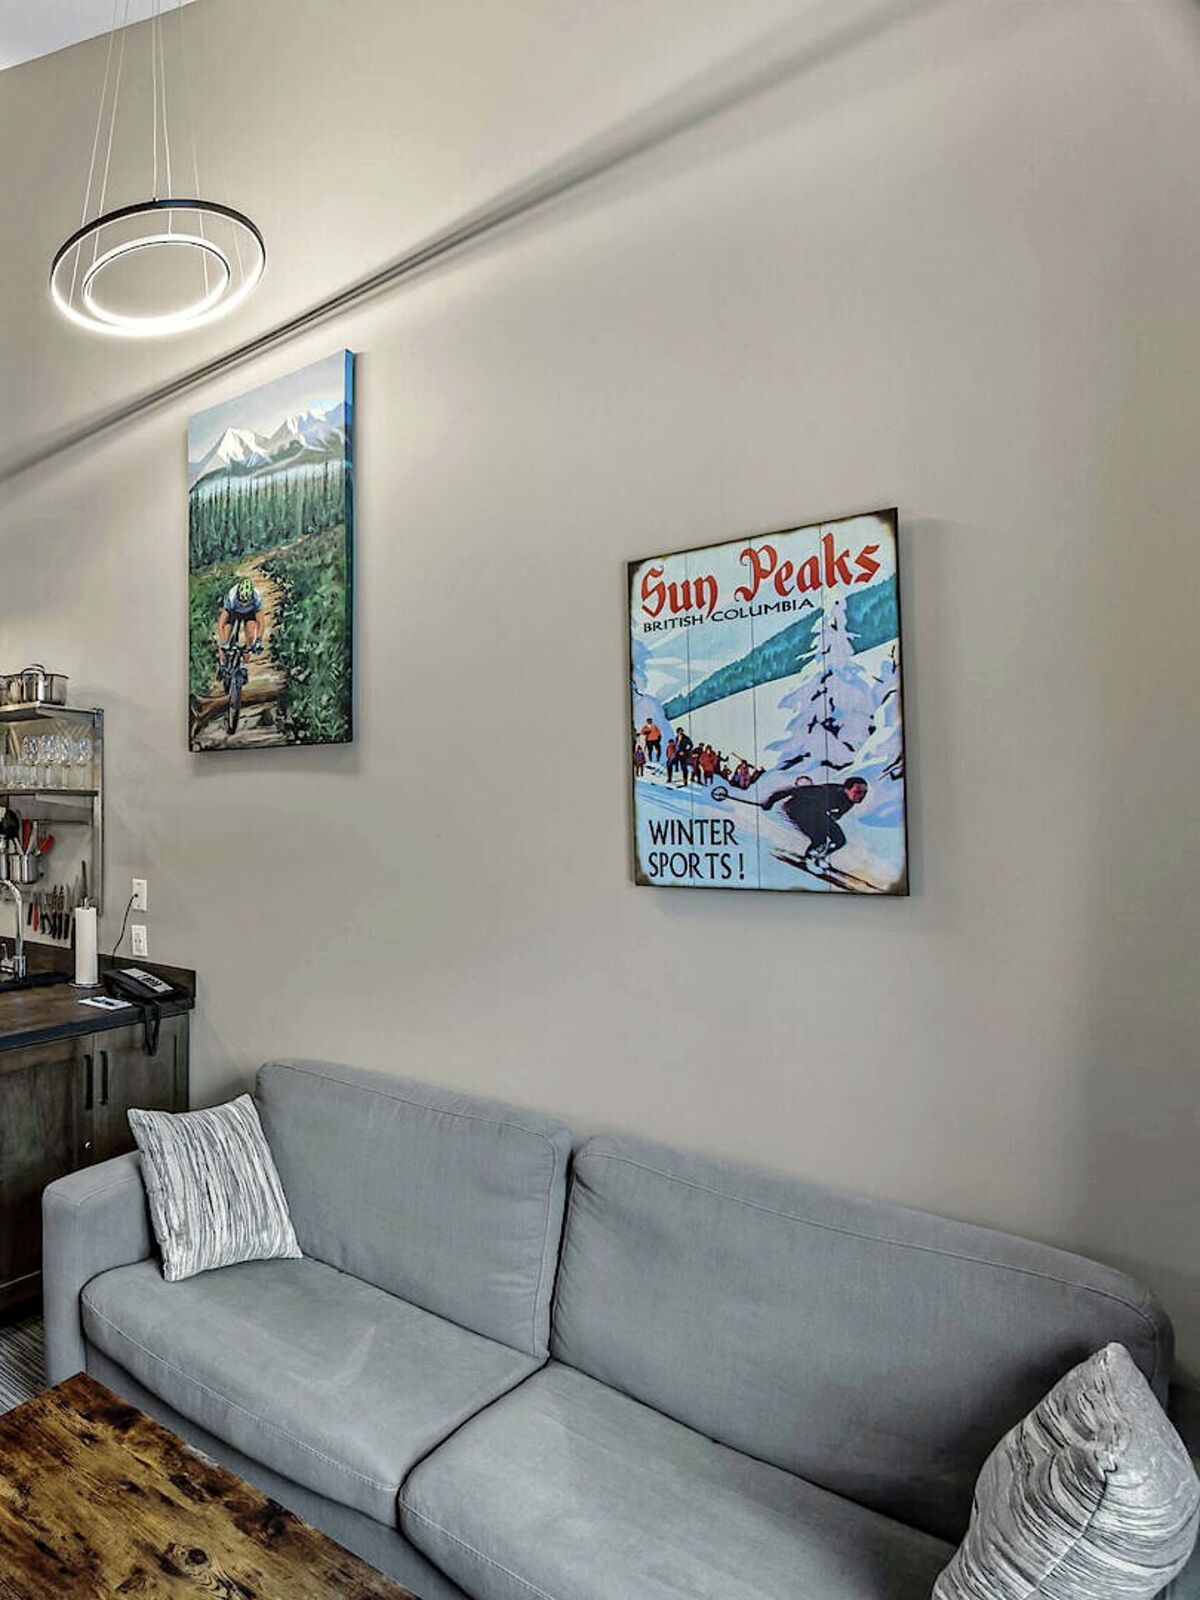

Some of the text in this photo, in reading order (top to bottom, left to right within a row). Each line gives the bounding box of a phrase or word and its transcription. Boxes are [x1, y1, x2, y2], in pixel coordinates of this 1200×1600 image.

[641, 532, 881, 618] Sun Peaks
[643, 598, 815, 633] BRITISH COLUMBIA
[648, 818, 739, 846] WINTER
